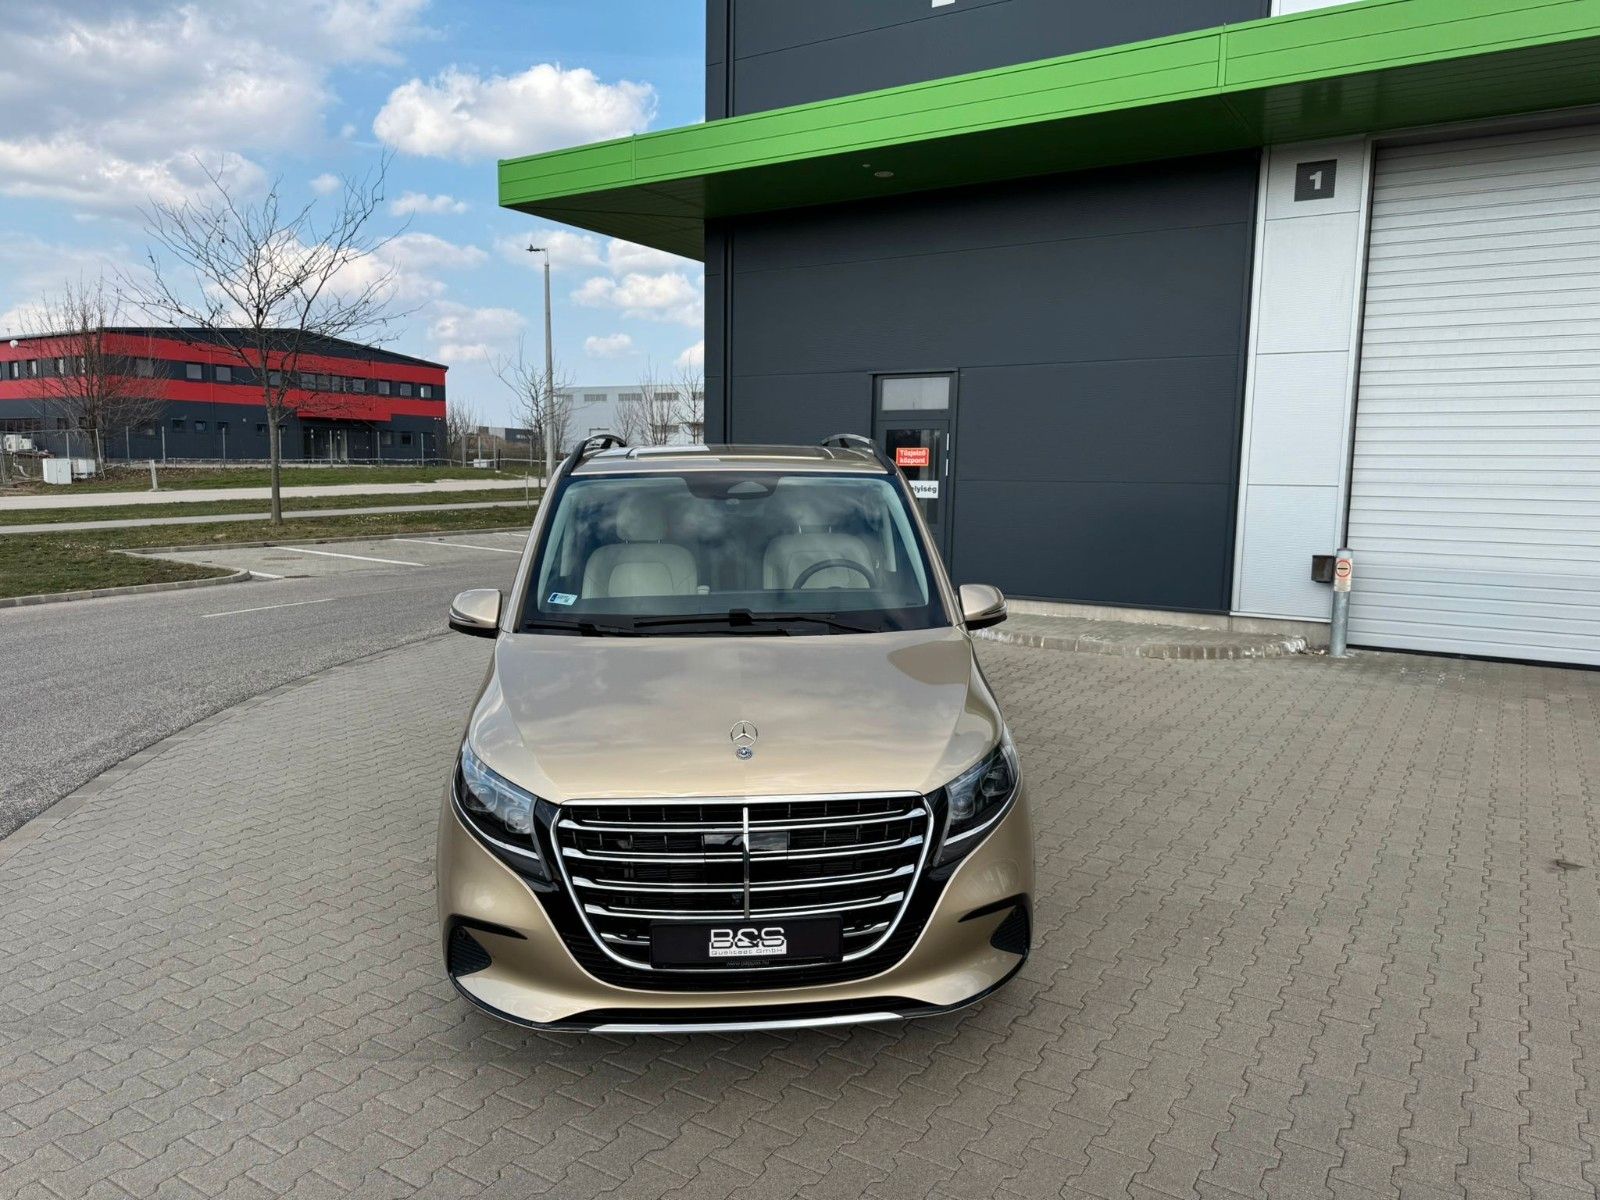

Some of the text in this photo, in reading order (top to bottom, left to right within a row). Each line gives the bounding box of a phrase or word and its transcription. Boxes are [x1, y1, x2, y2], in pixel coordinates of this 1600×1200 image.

[1309, 170, 1322, 190] 1
[899, 457, 926, 465] központ
[710, 927, 785, 949] B&S
